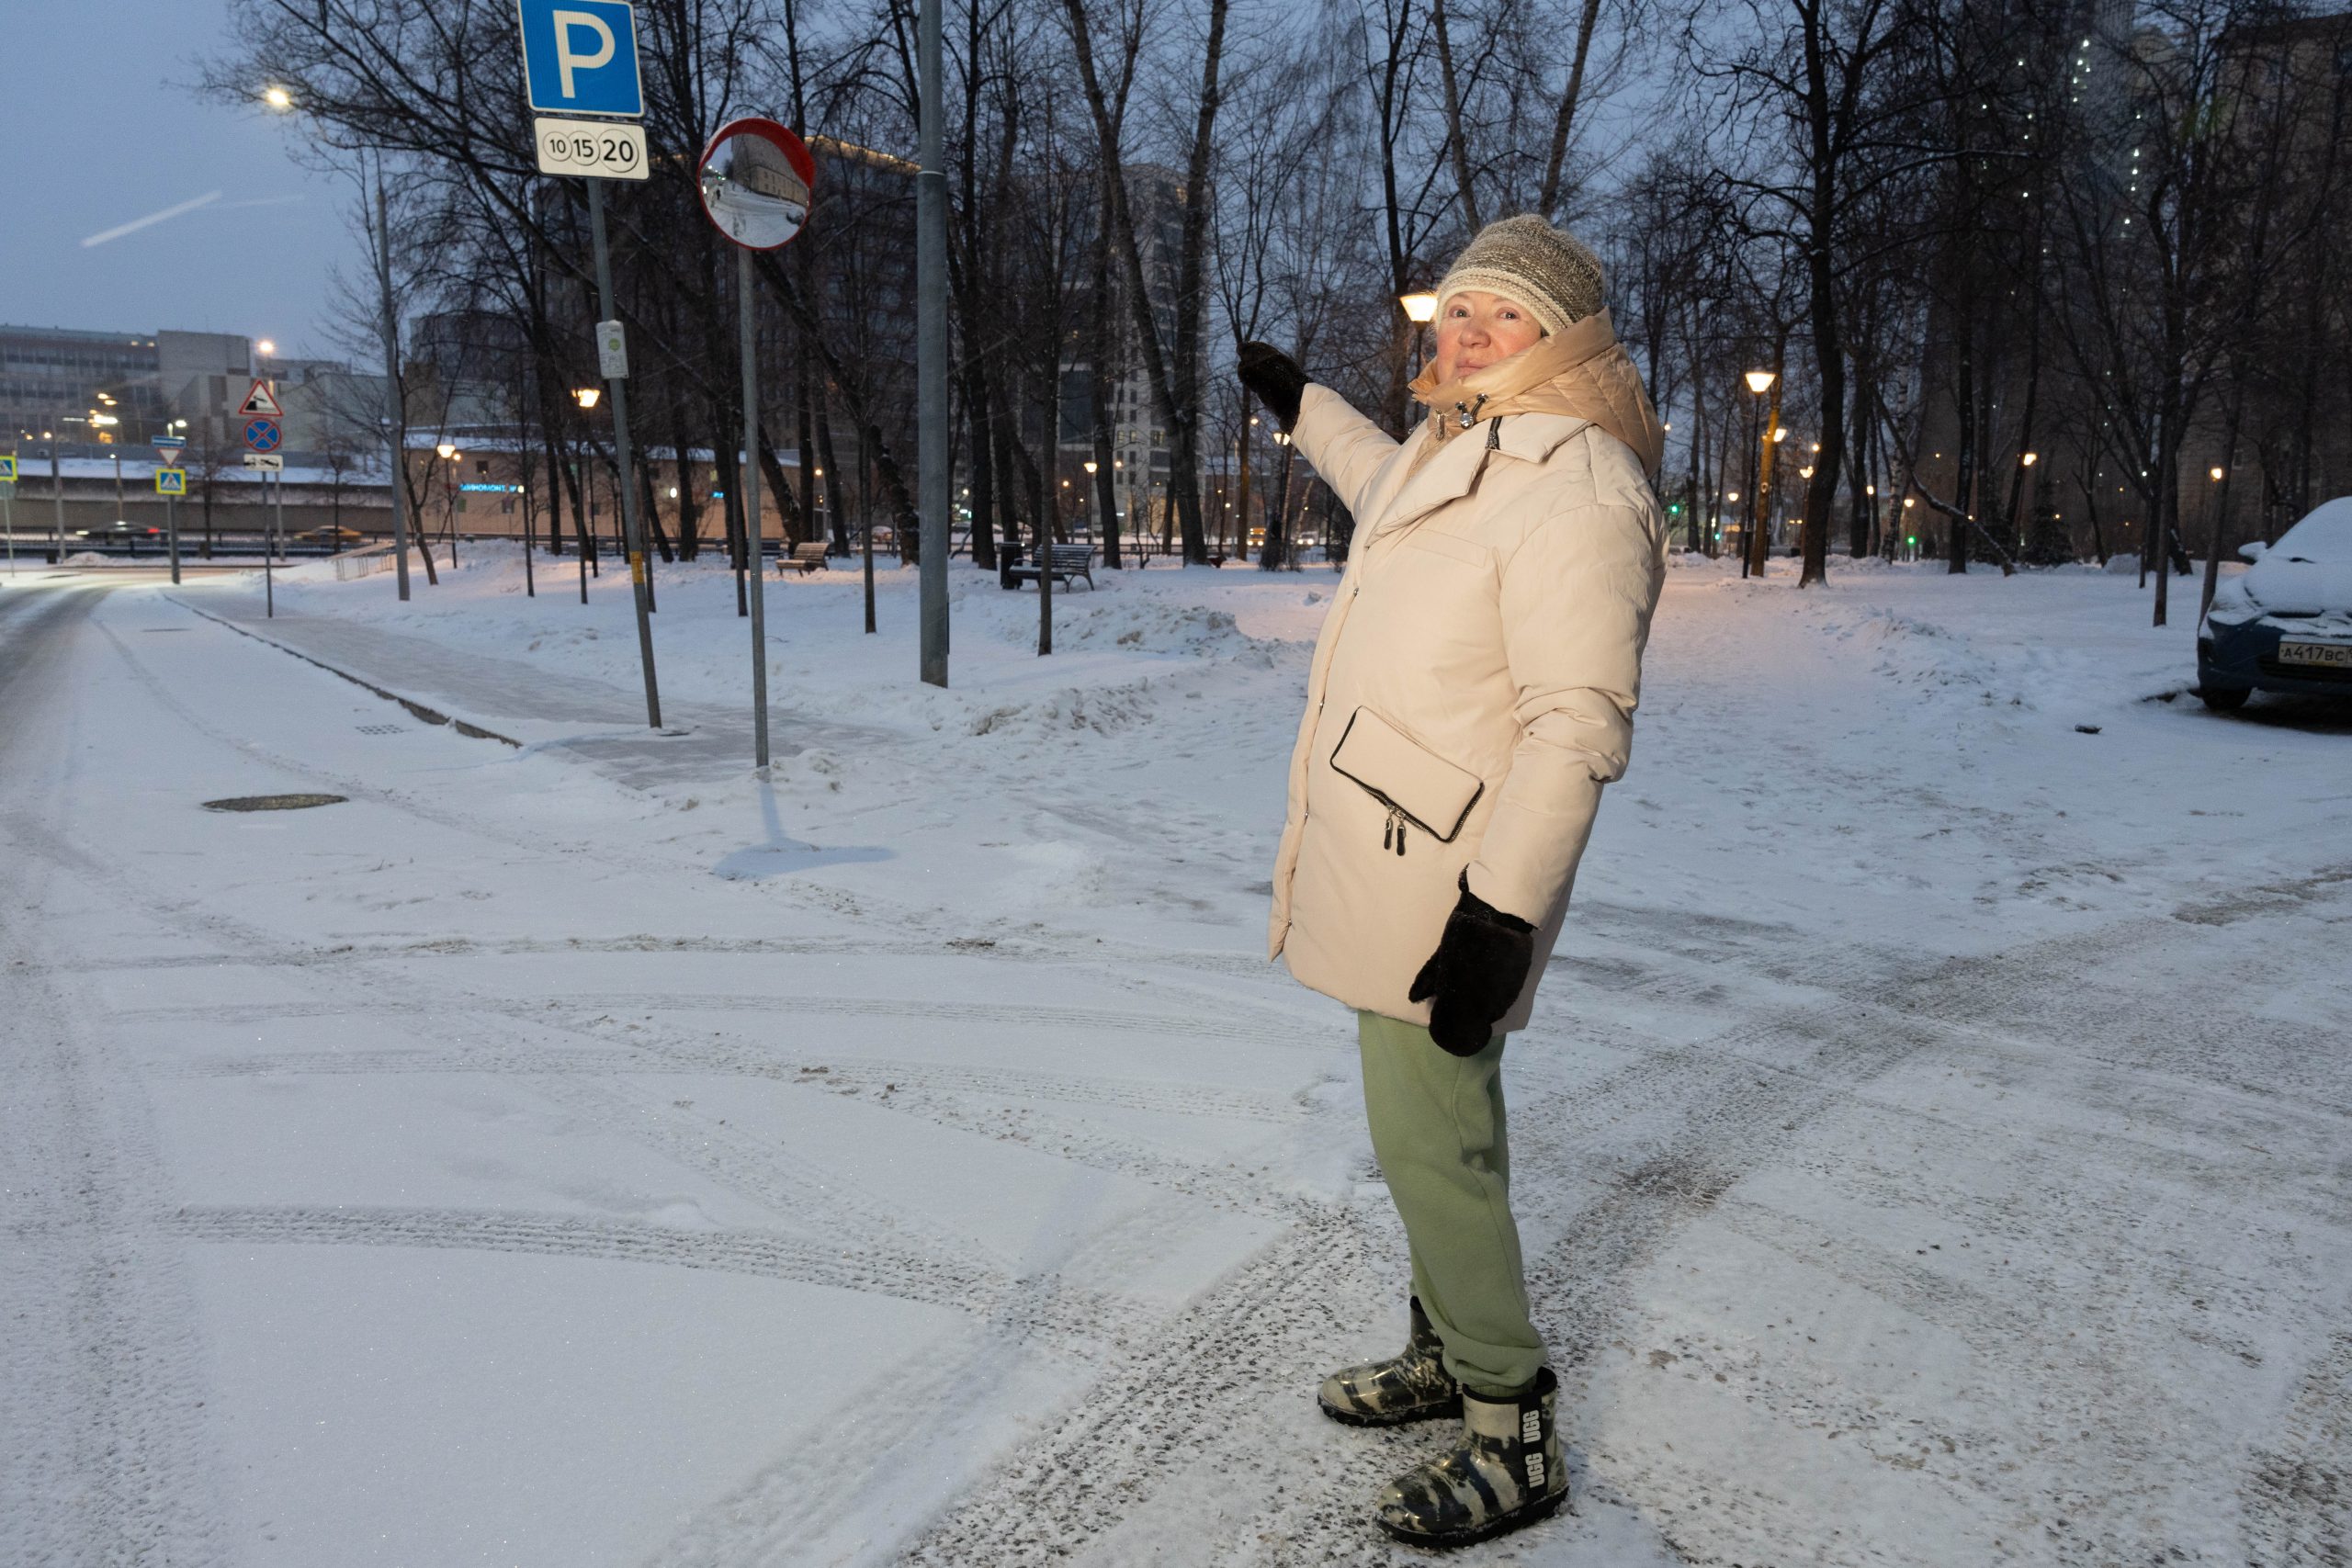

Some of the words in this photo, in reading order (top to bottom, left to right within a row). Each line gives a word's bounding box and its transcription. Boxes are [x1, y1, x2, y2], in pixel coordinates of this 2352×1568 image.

[553, 10, 616, 98] P
[549, 139, 566, 153] 10
[573, 139, 594, 158] 15
[602, 139, 634, 163] 20
[1522, 1409, 1542, 1444] UGG
[1525, 1452, 1545, 1488] UGG
